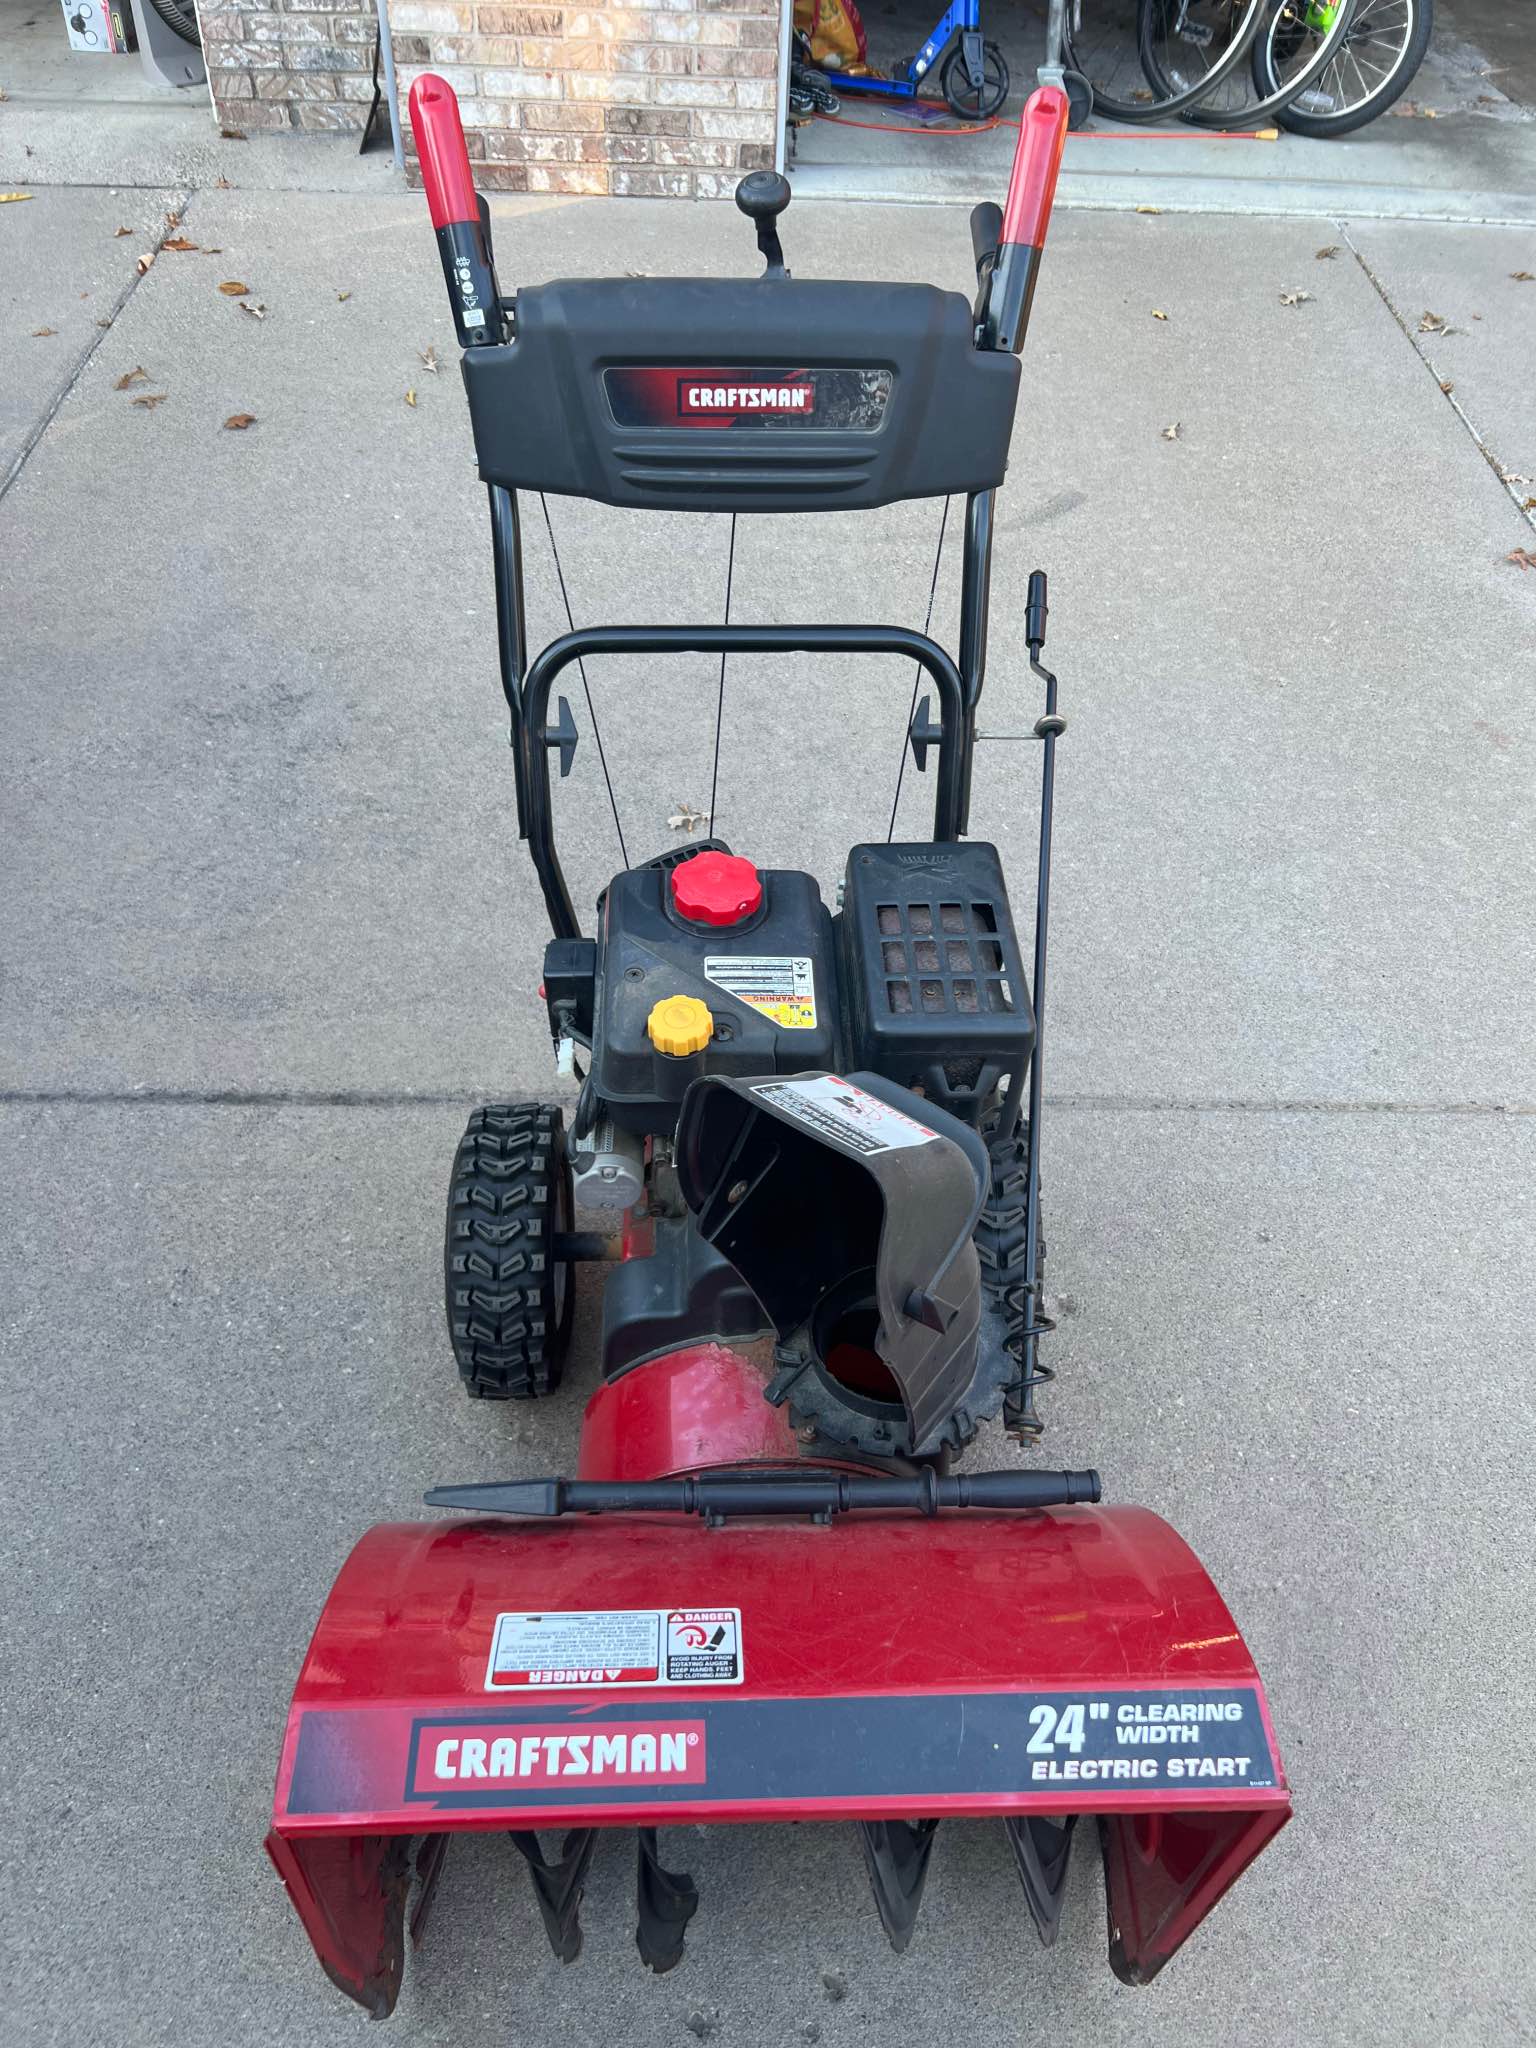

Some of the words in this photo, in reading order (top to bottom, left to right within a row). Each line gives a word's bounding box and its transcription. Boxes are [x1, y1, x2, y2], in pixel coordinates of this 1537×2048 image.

[688, 387, 807, 408] CRAFTSMAN
[685, 1613, 733, 1621] DANGER
[529, 1670, 604, 1682] DANGER
[1026, 1703, 1109, 1754] 24"
[1117, 1703, 1243, 1722] CLEARING
[1116, 1725, 1200, 1744] WIDTH
[434, 1732, 688, 1779] CRAFTSMAN
[1031, 1759, 1158, 1780] ELECTRIC
[1166, 1757, 1251, 1777] START
